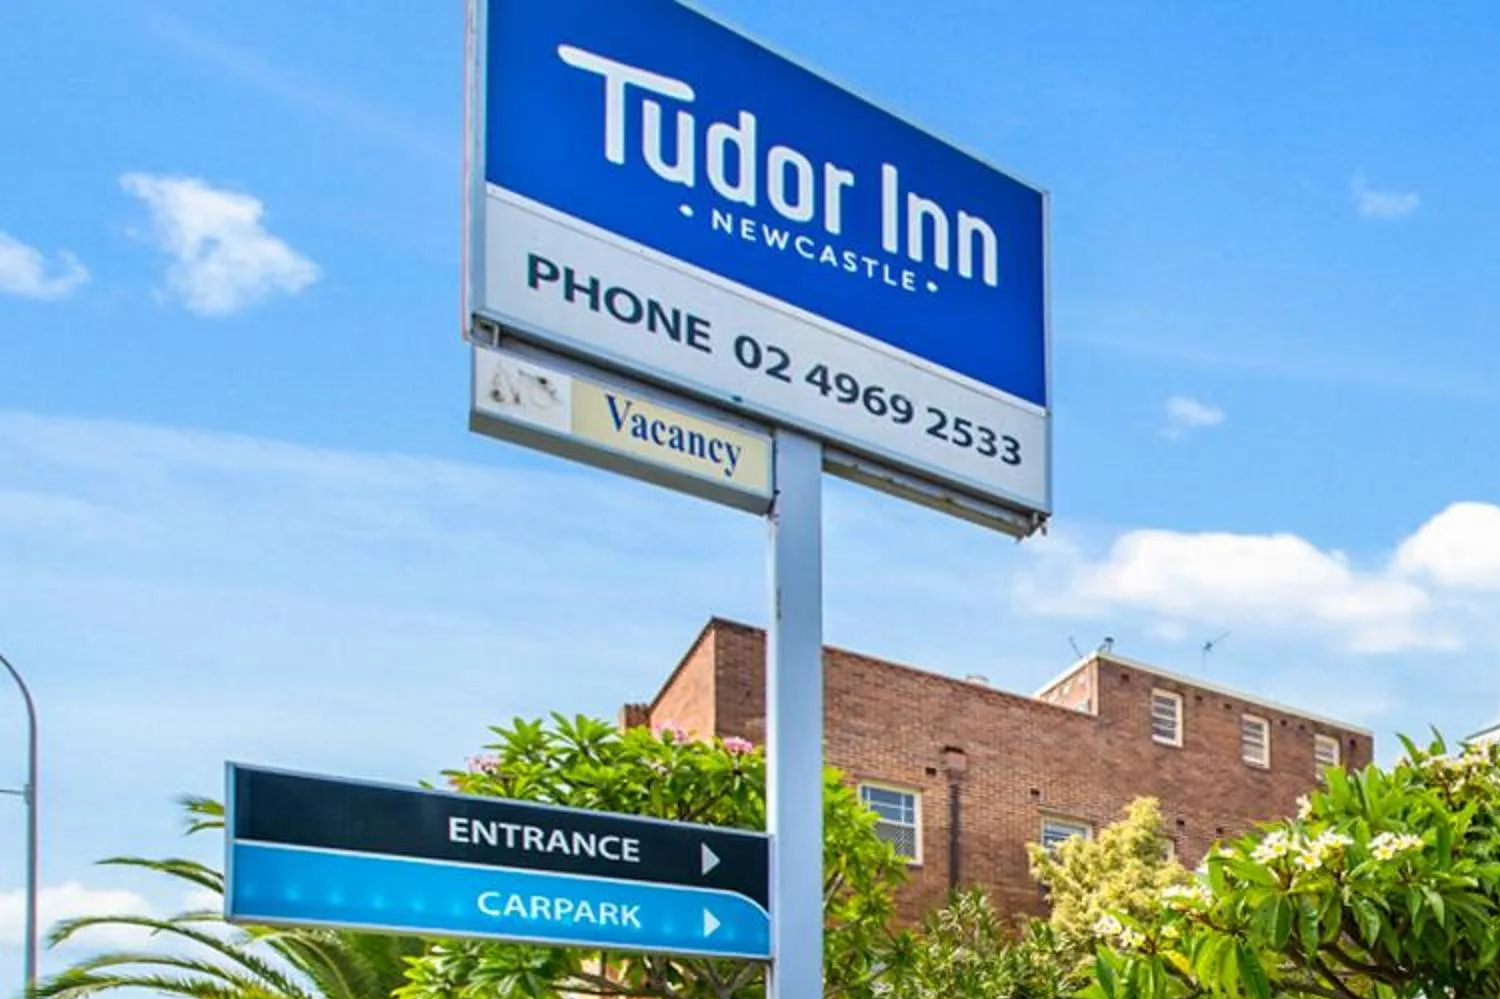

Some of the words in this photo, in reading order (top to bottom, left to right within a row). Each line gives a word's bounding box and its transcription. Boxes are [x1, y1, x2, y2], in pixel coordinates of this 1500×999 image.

[558, 44, 854, 235] Tudor
[881, 162, 998, 286] Inn
[711, 208, 916, 291] NEWCASTLE
[526, 252, 712, 353] PHONE
[733, 335, 792, 384] 02
[805, 363, 914, 426] 4969
[926, 406, 1023, 466] 2533
[605, 392, 743, 477] Vacancy
[448, 816, 641, 863] ENTRANCE
[477, 891, 642, 929] CARPARK
